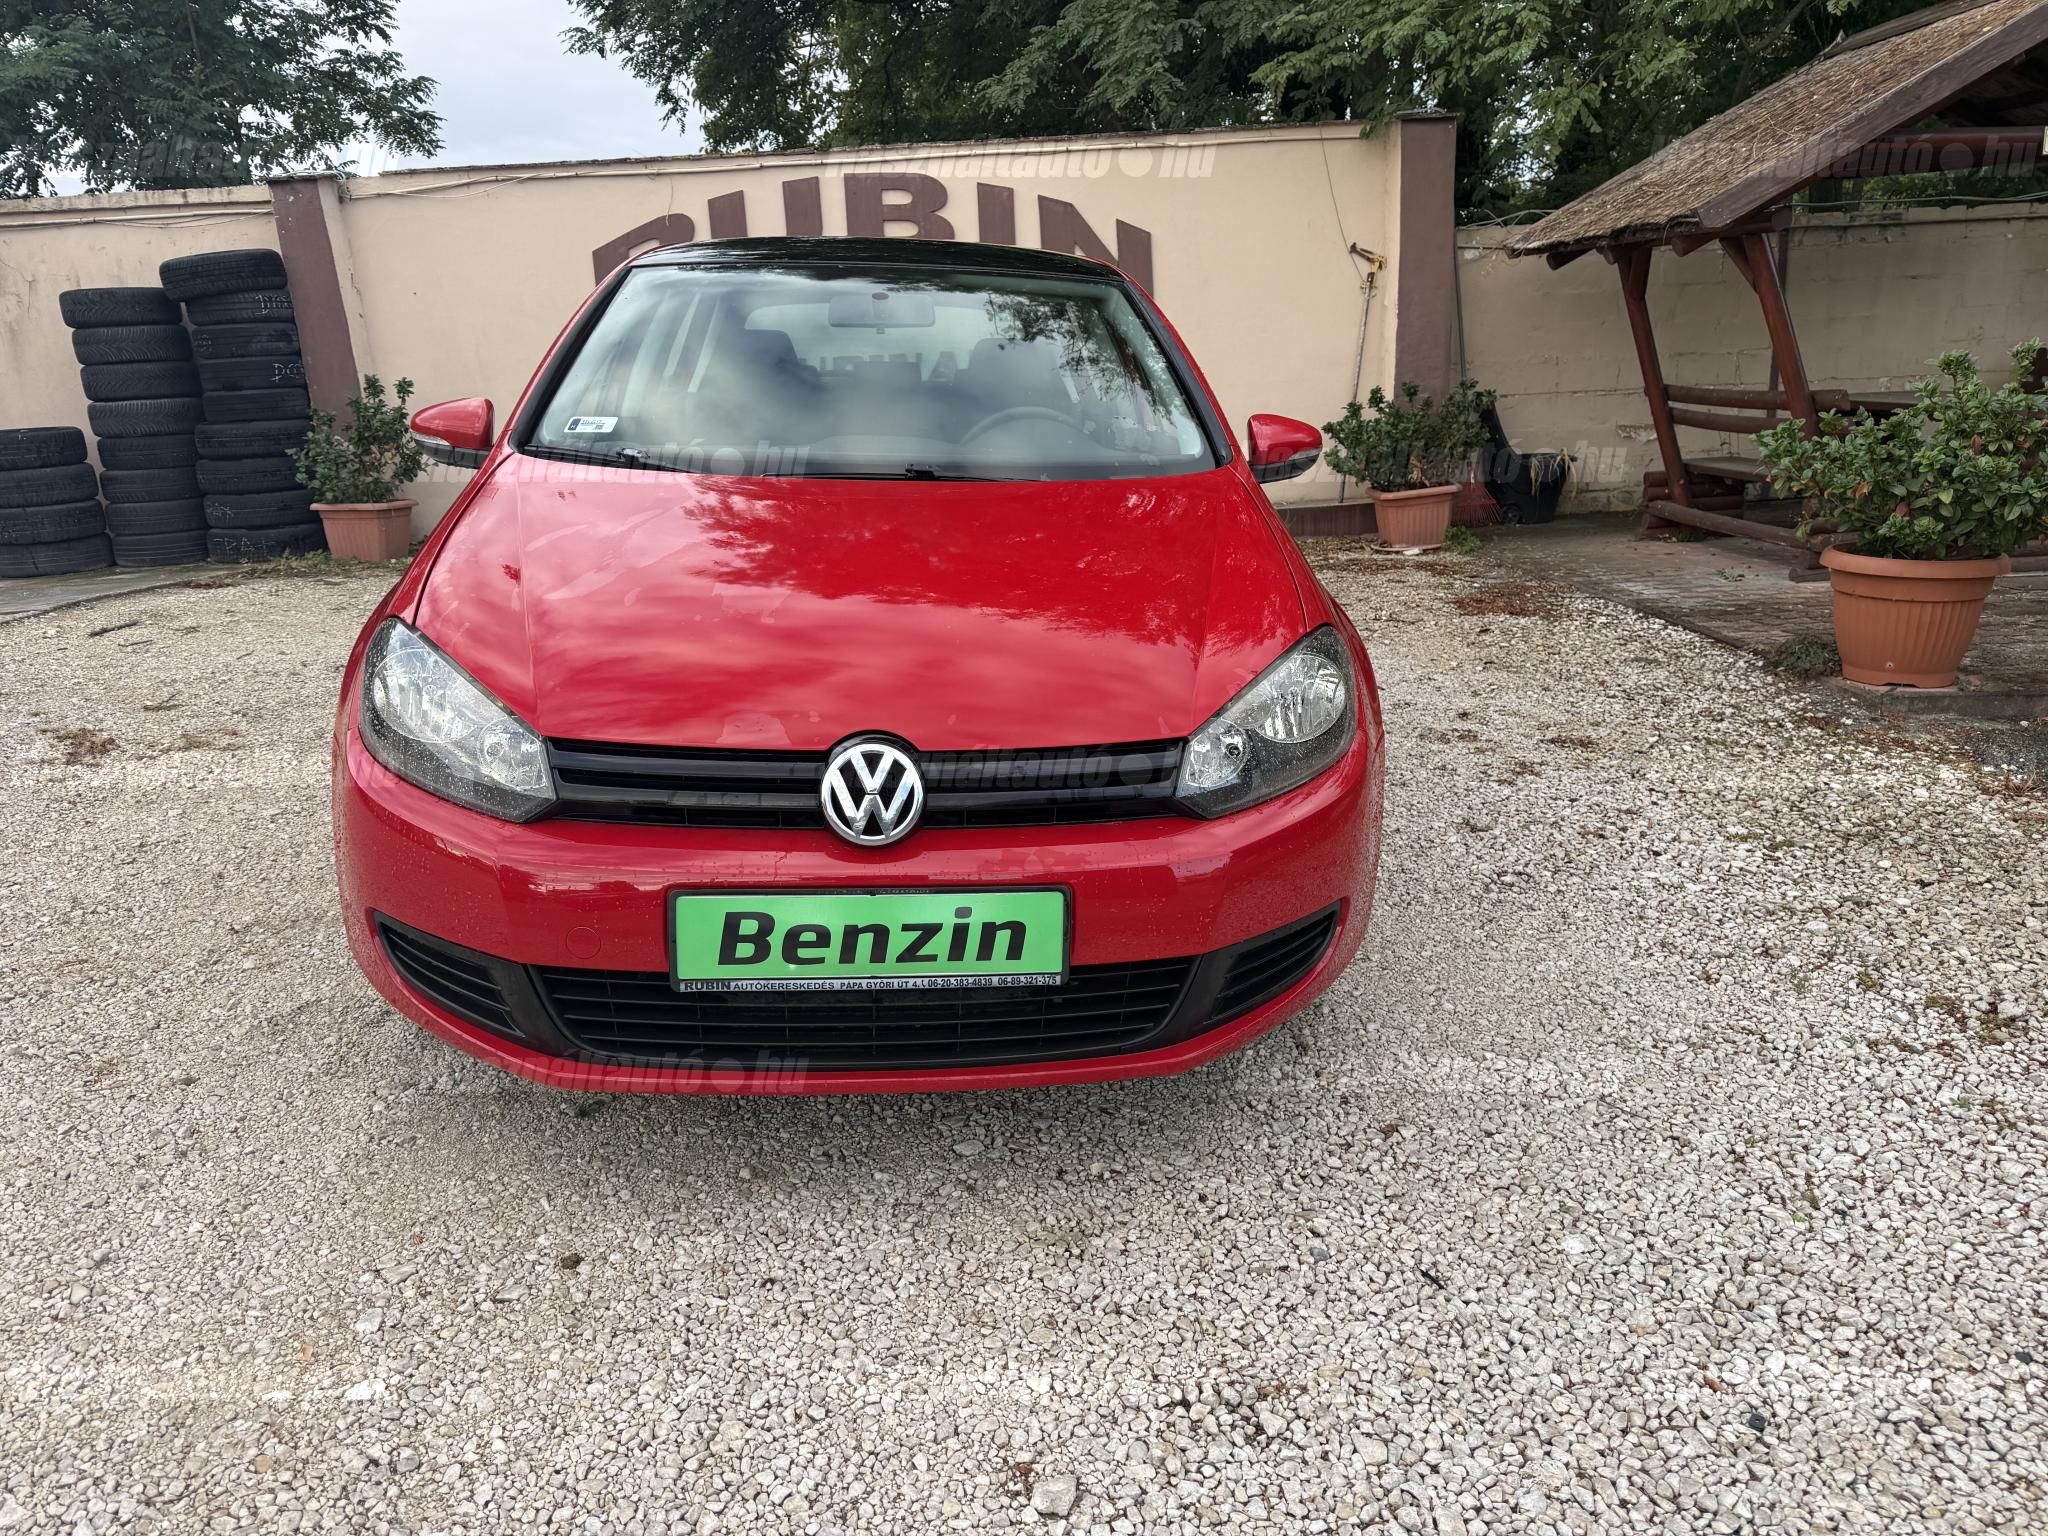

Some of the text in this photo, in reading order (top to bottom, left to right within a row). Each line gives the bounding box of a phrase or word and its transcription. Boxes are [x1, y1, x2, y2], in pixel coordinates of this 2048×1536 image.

[824, 746, 920, 842] VW
[718, 906, 1028, 966] Benzin
[684, 981, 731, 991] RUBIN
[733, 980, 835, 991] AUTÓKERESKEDÉS
[840, 980, 864, 990] PÁPA
[928, 977, 993, 988] 06-20-383-4839
[997, 975, 1057, 986] 06-89-321-375
